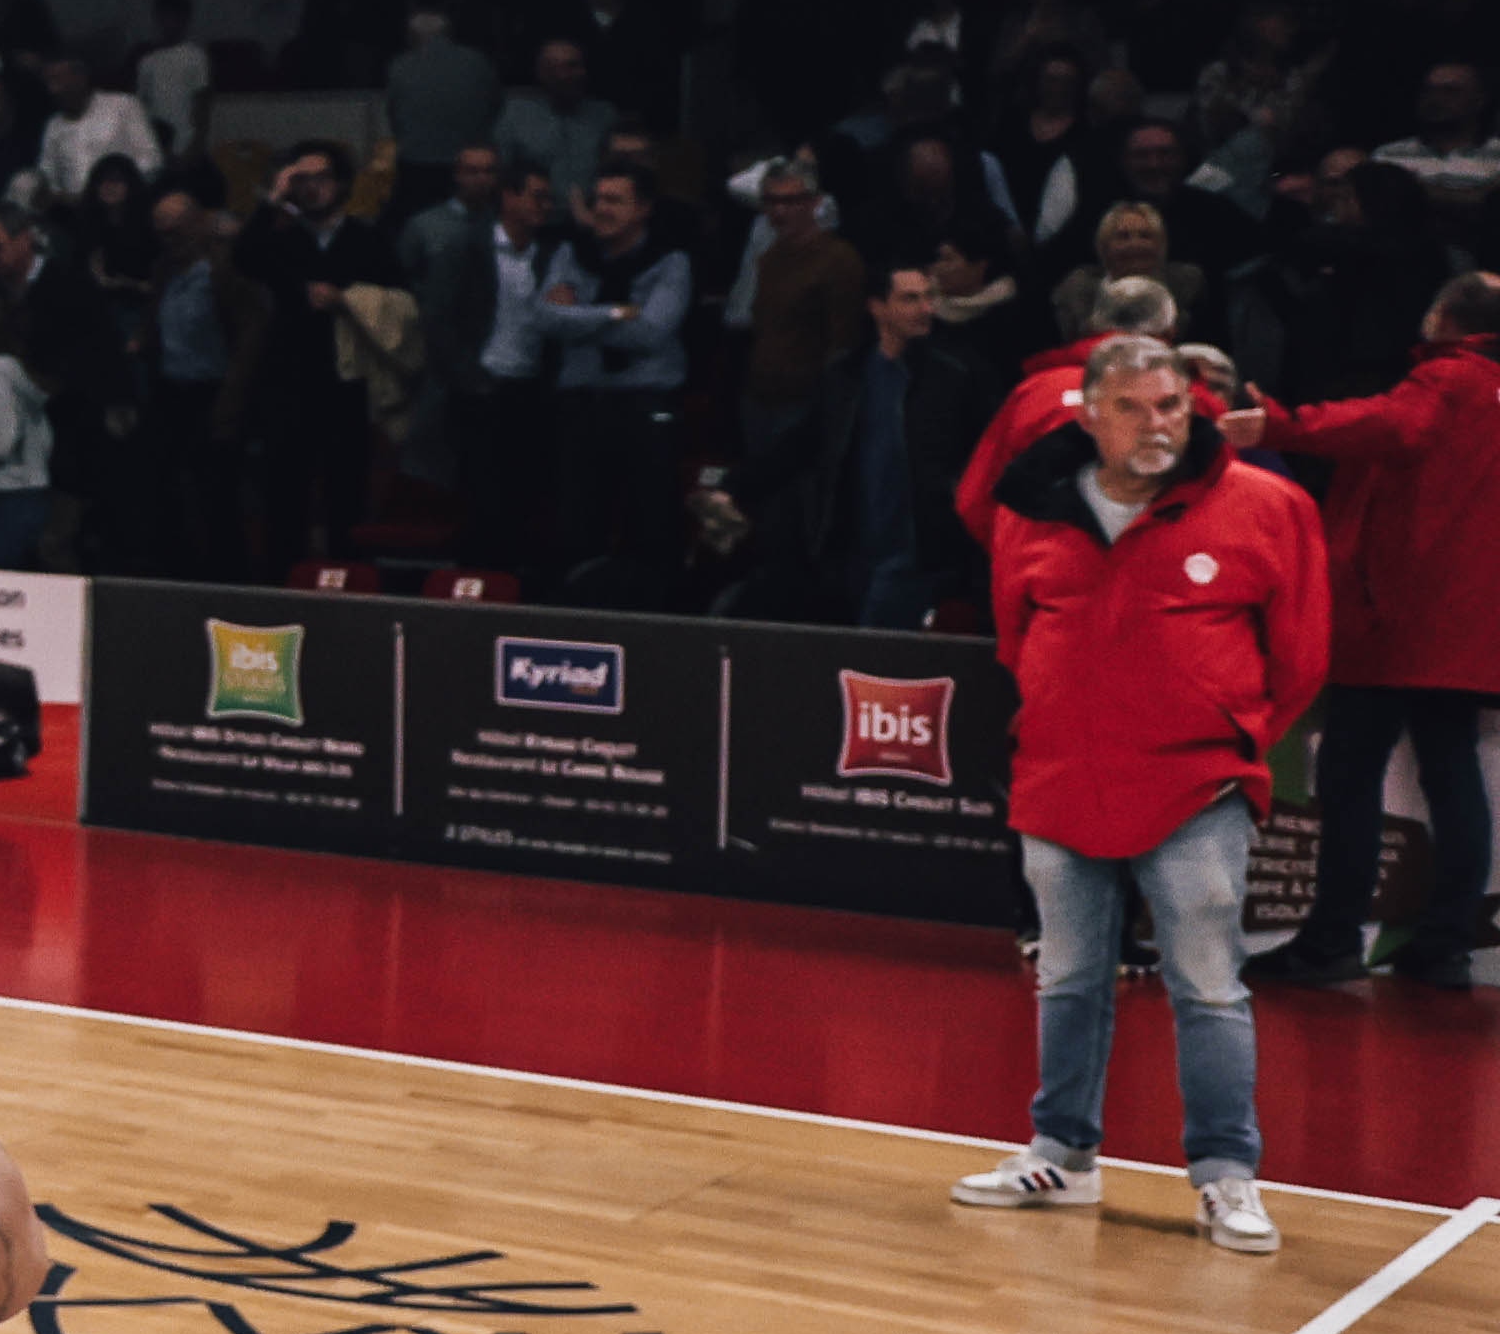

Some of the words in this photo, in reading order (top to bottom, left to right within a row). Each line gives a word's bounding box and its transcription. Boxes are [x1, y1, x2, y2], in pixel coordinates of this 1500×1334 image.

[229, 643, 279, 672] ibis
[509, 656, 607, 688] Kyriad
[857, 701, 933, 746] ibis
